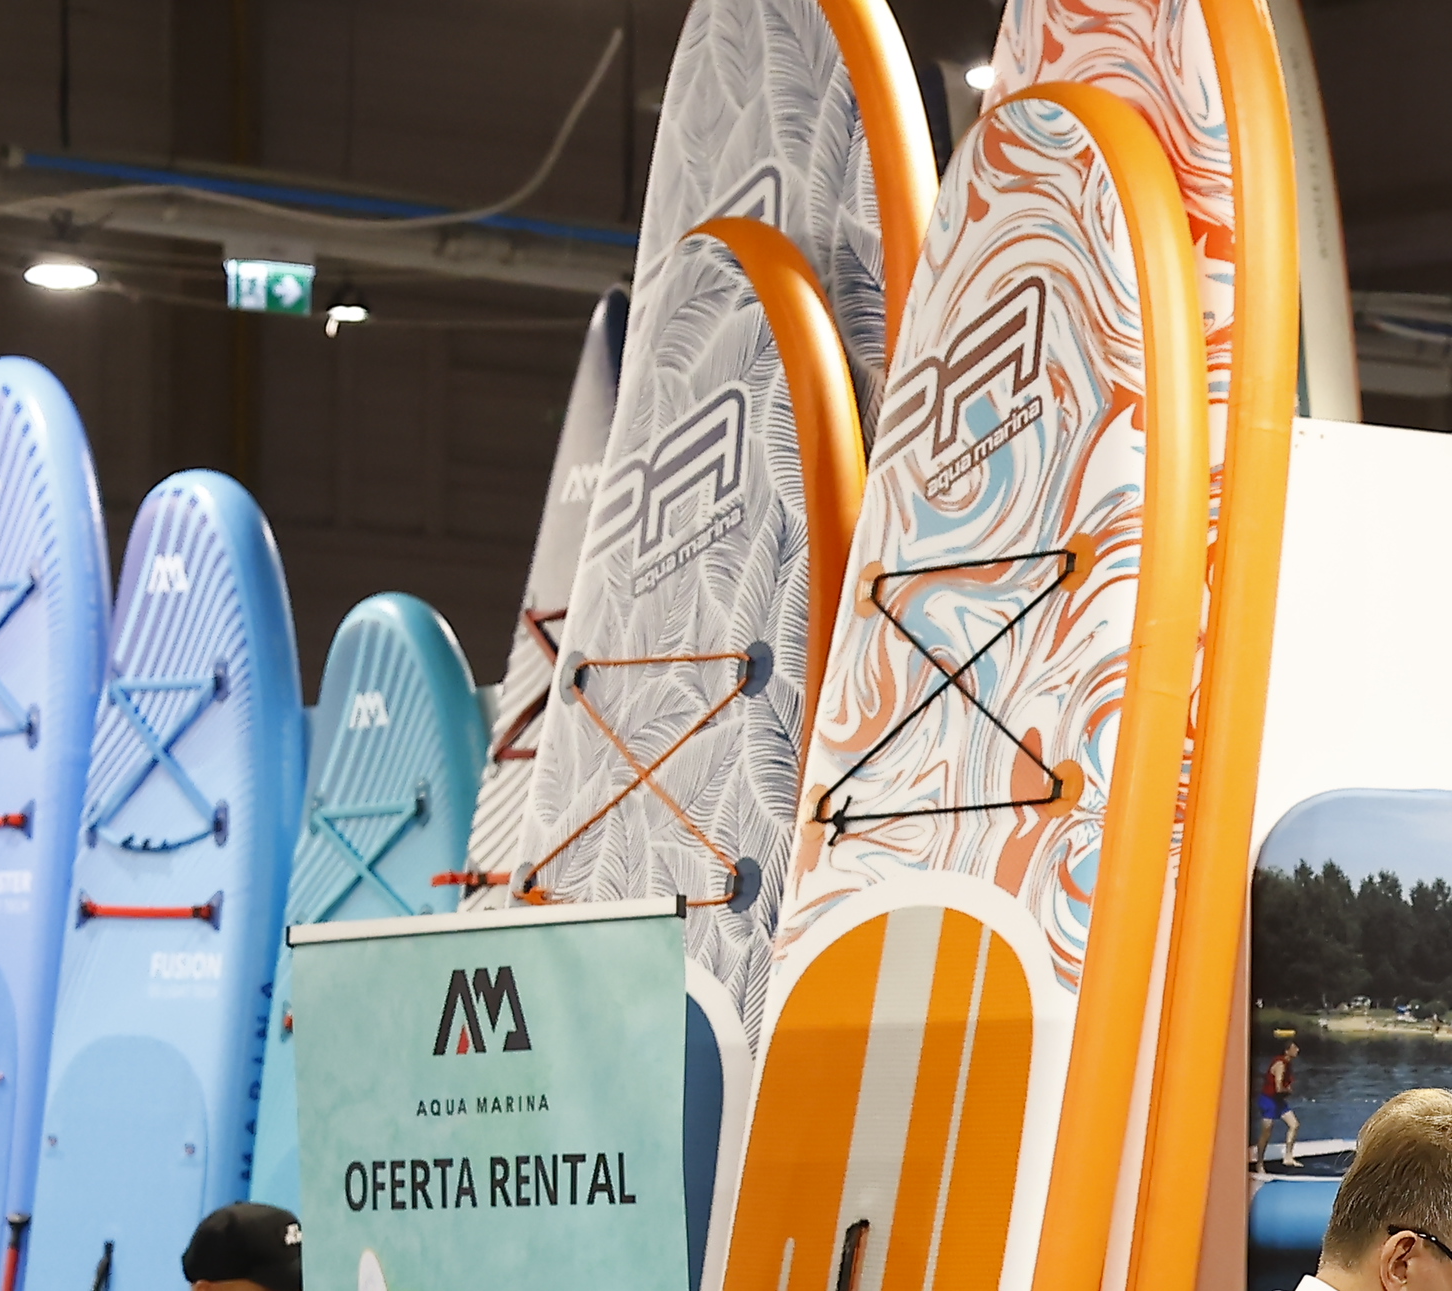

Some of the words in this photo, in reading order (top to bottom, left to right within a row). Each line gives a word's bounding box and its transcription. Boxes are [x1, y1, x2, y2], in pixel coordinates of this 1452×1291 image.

[926, 452, 971, 500] aqua
[970, 395, 1044, 462] marina
[631, 548, 677, 598] aqua
[675, 504, 743, 573] marina
[149, 951, 223, 981] FUSION
[416, 1097, 469, 1117] AQUA
[476, 1094, 550, 1115] MARINA
[345, 1156, 478, 1212] OFERTA
[489, 1152, 637, 1208] RENTAL
